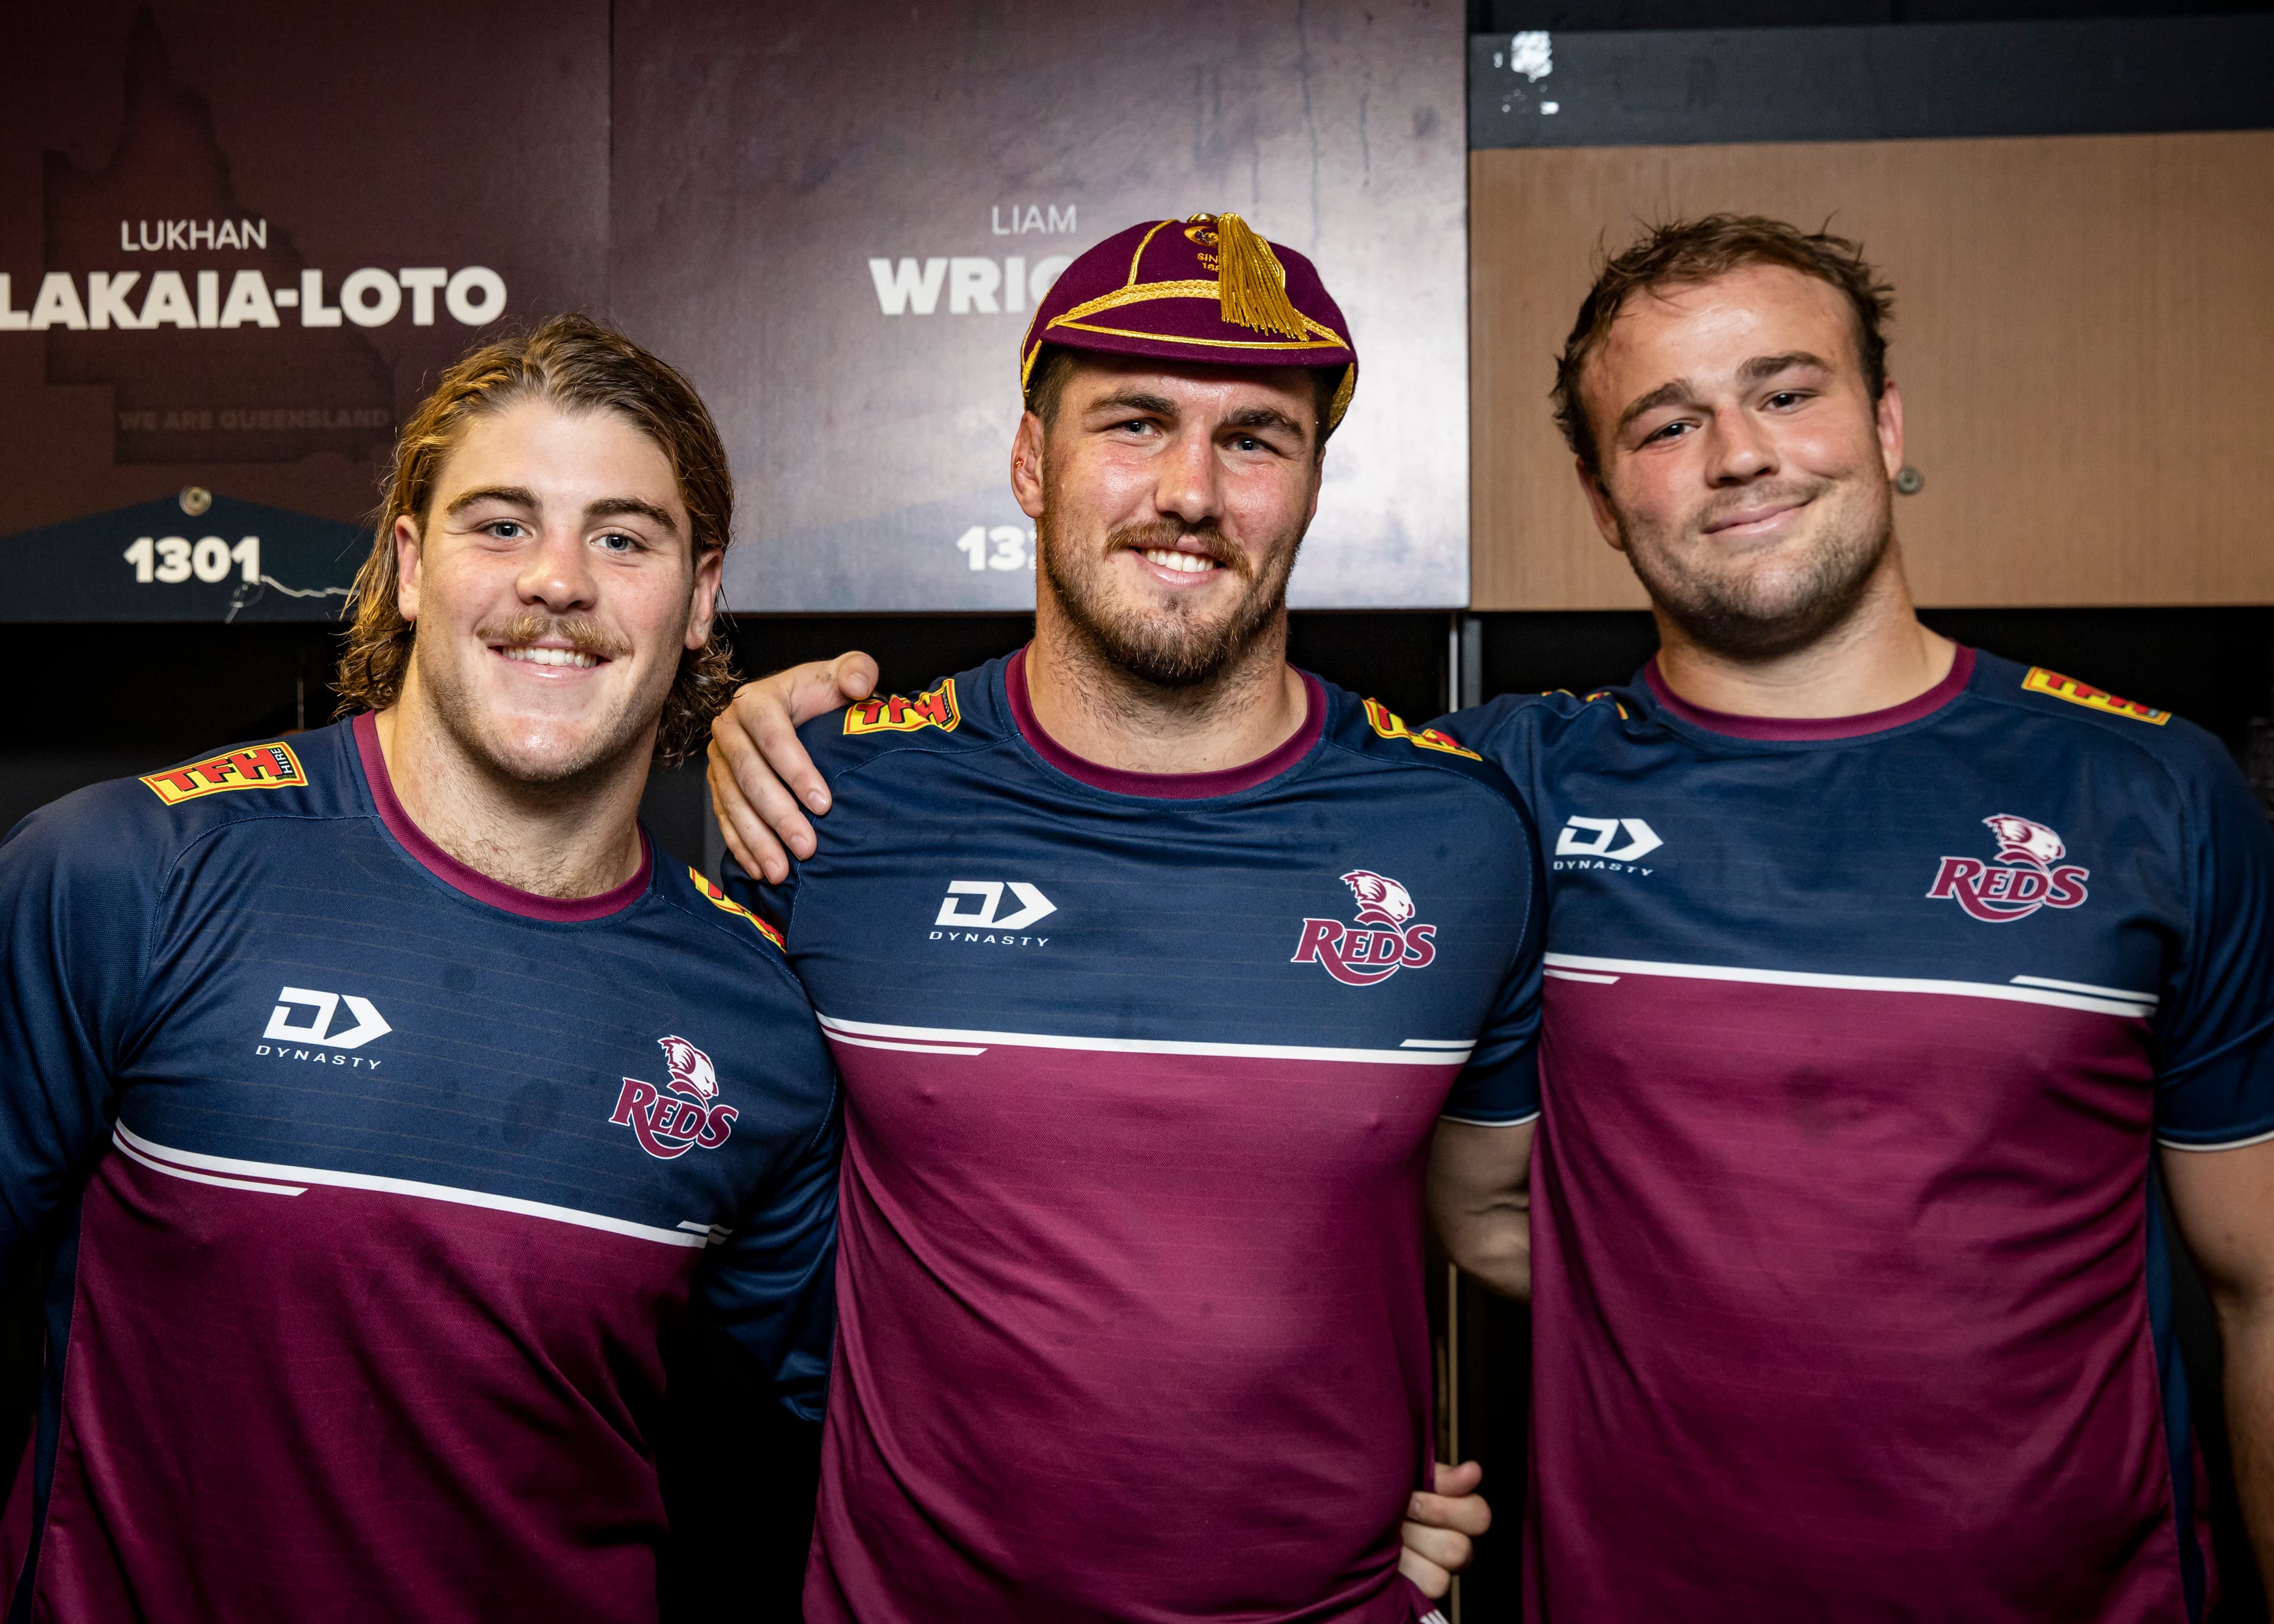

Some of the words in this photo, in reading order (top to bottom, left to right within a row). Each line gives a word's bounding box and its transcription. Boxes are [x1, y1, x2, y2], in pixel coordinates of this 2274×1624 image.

[121, 218, 267, 252] LUKHAN
[991, 204, 1077, 234] LIAM
[0, 265, 508, 331] LAKAIA-LOTO
[118, 410, 157, 431] WE
[163, 410, 213, 430] ARE
[219, 407, 390, 430] QUEENSLAND
[123, 535, 260, 585] 1301
[955, 525, 1036, 571] 13
[152, 748, 285, 792] TFH
[269, 748, 293, 774] HIRE
[1553, 860, 1654, 876] DYNASTY
[929, 931, 1049, 947] DYNASTY
[255, 1045, 381, 1070] DYNASTY
